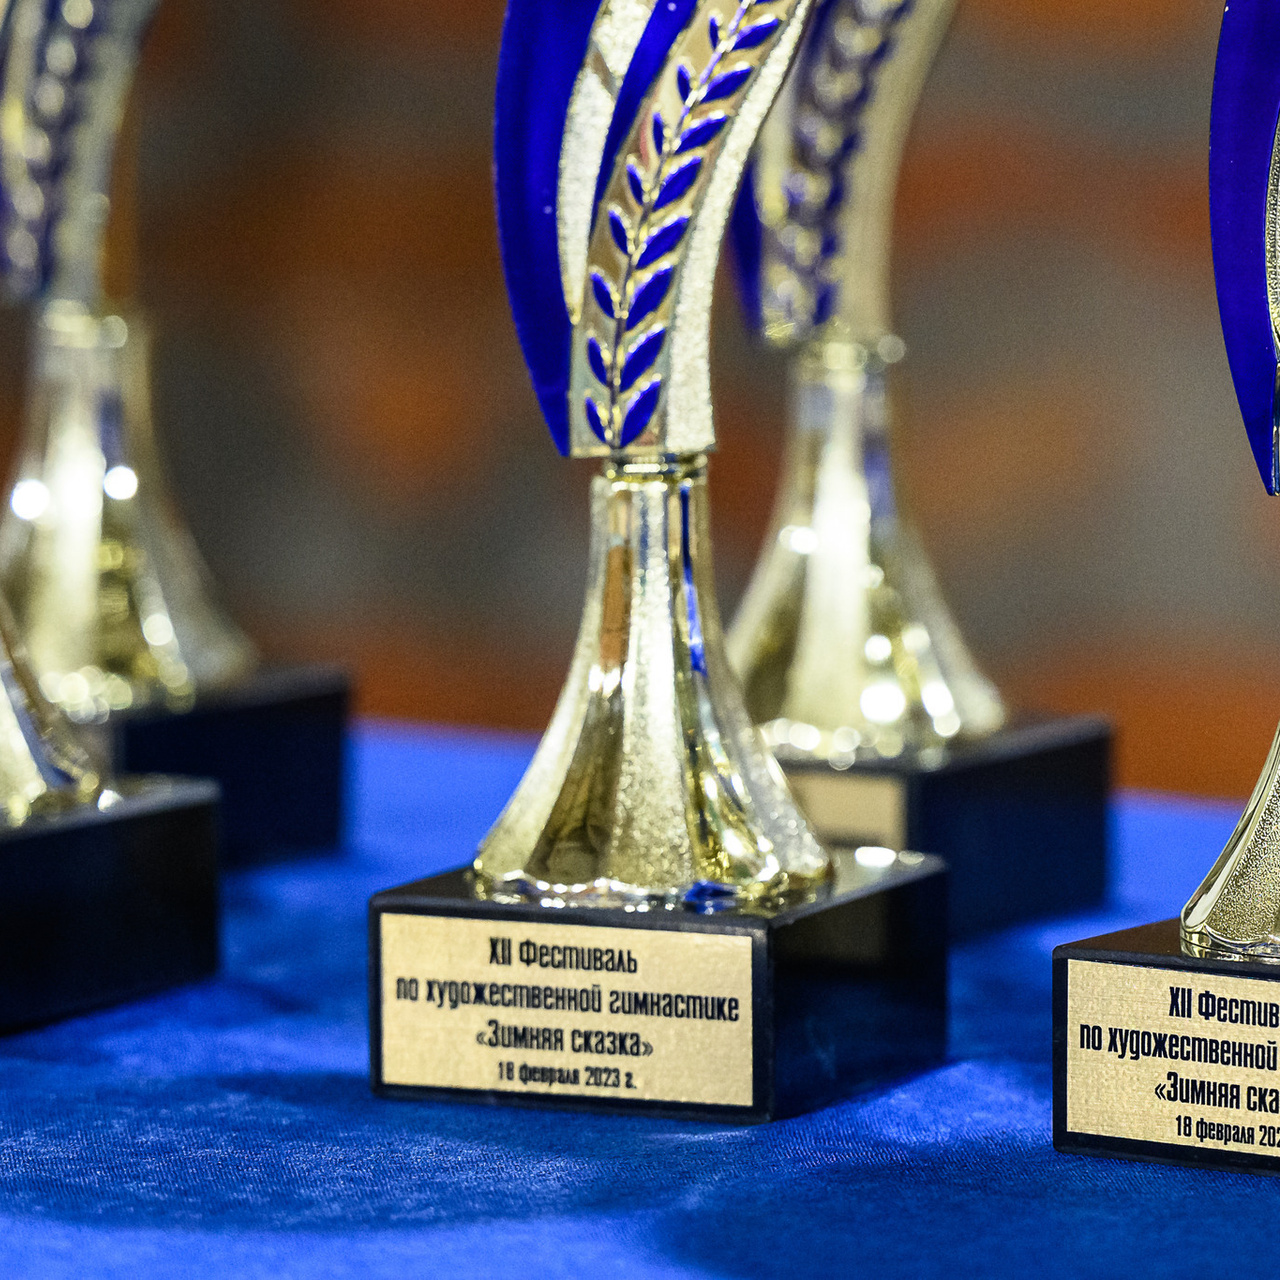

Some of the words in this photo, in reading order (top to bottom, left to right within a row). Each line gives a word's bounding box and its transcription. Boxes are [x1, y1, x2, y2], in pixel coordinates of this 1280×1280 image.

[488, 936, 511, 965] XII
[519, 938, 638, 973] Фестиваль
[396, 977, 418, 1001] по
[426, 979, 601, 1013] художественной
[609, 989, 740, 1022] гимнастике
[1168, 986, 1192, 1019] XII
[1079, 1023, 1102, 1051] по
[1108, 1026, 1278, 1073] художественной
[499, 1061, 514, 1081] 18
[519, 1063, 580, 1088] февраля
[585, 1065, 621, 1089] 2023
[1154, 1071, 1241, 1110] «Зимняя
[1175, 1115, 1191, 1137] 18
[1195, 1117, 1255, 1145] февраля
